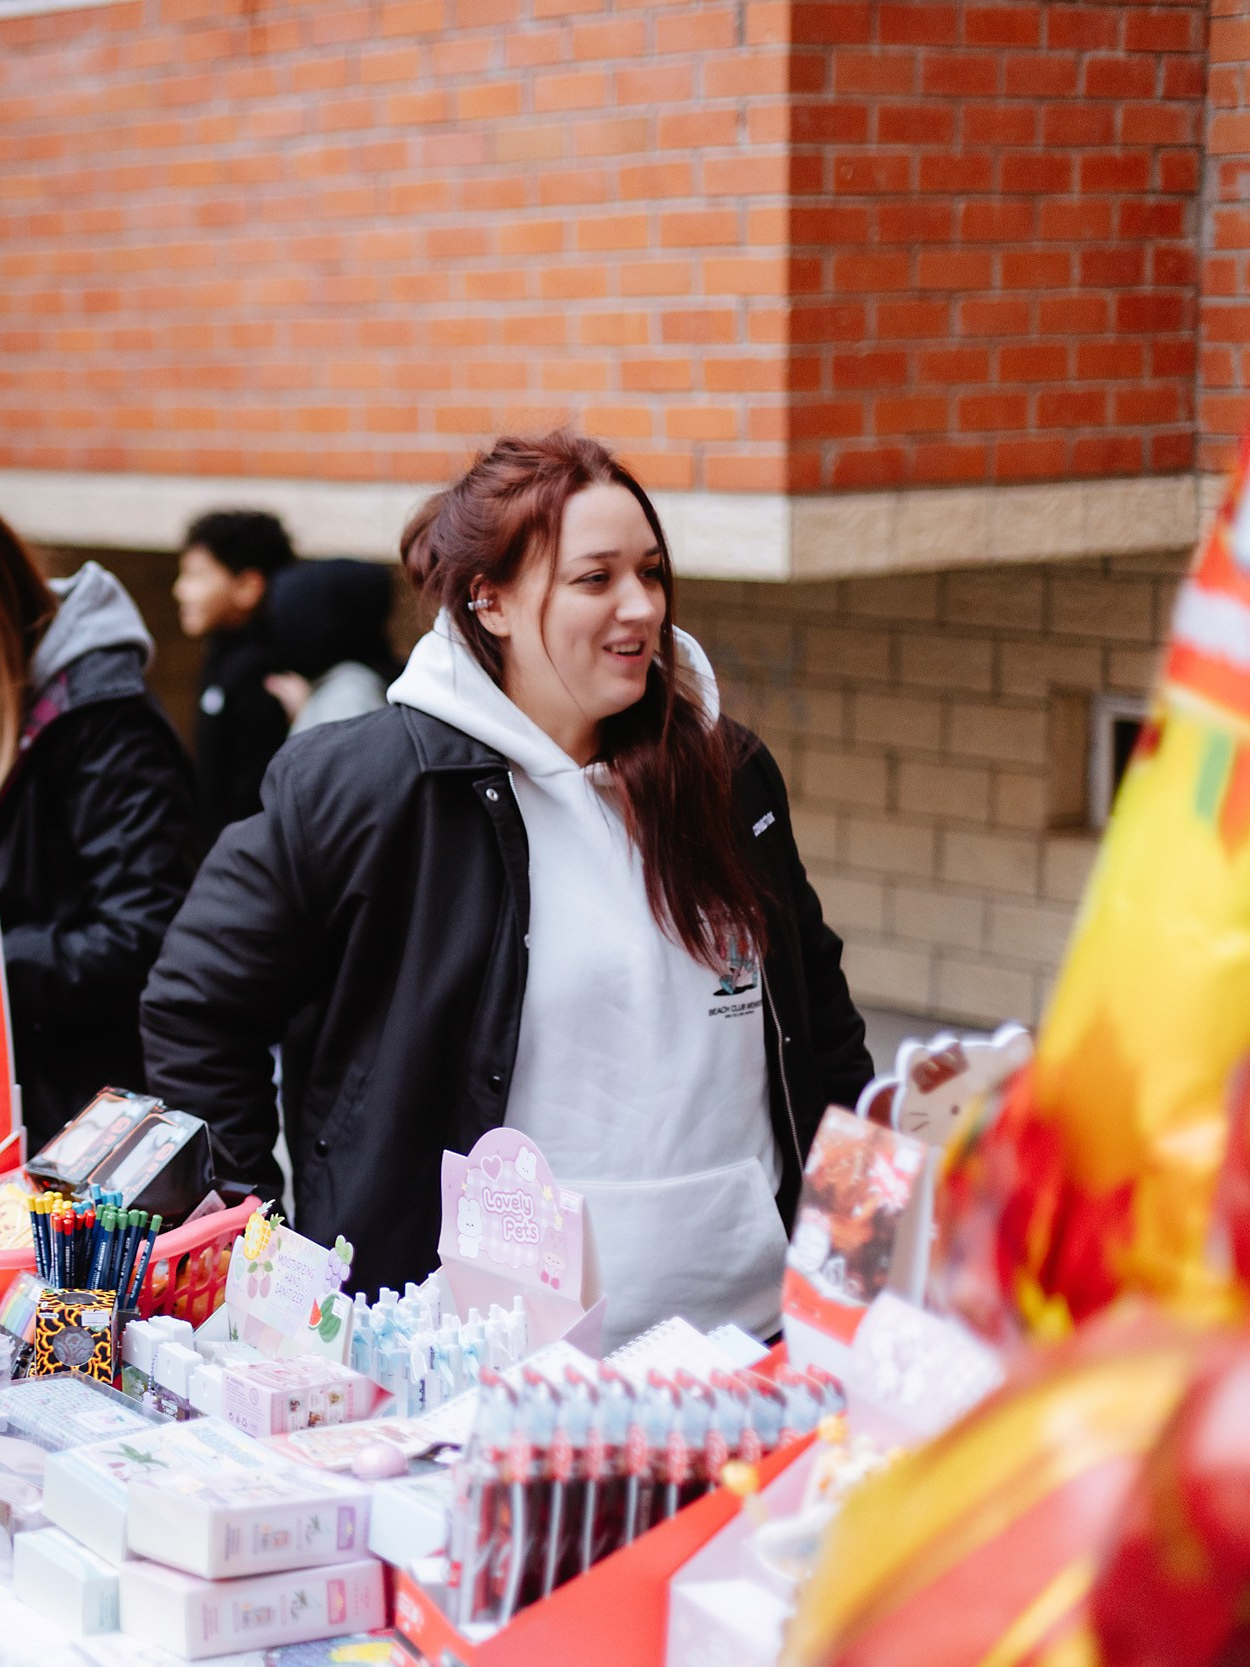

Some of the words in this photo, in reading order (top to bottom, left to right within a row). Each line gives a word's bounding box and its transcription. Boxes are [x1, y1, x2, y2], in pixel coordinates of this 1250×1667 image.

[483, 1187, 534, 1220] Lovely
[503, 1216, 539, 1243] Pets
[278, 1254, 315, 1279] MOISTURIZING
[274, 1282, 305, 1305] SANITIZER
